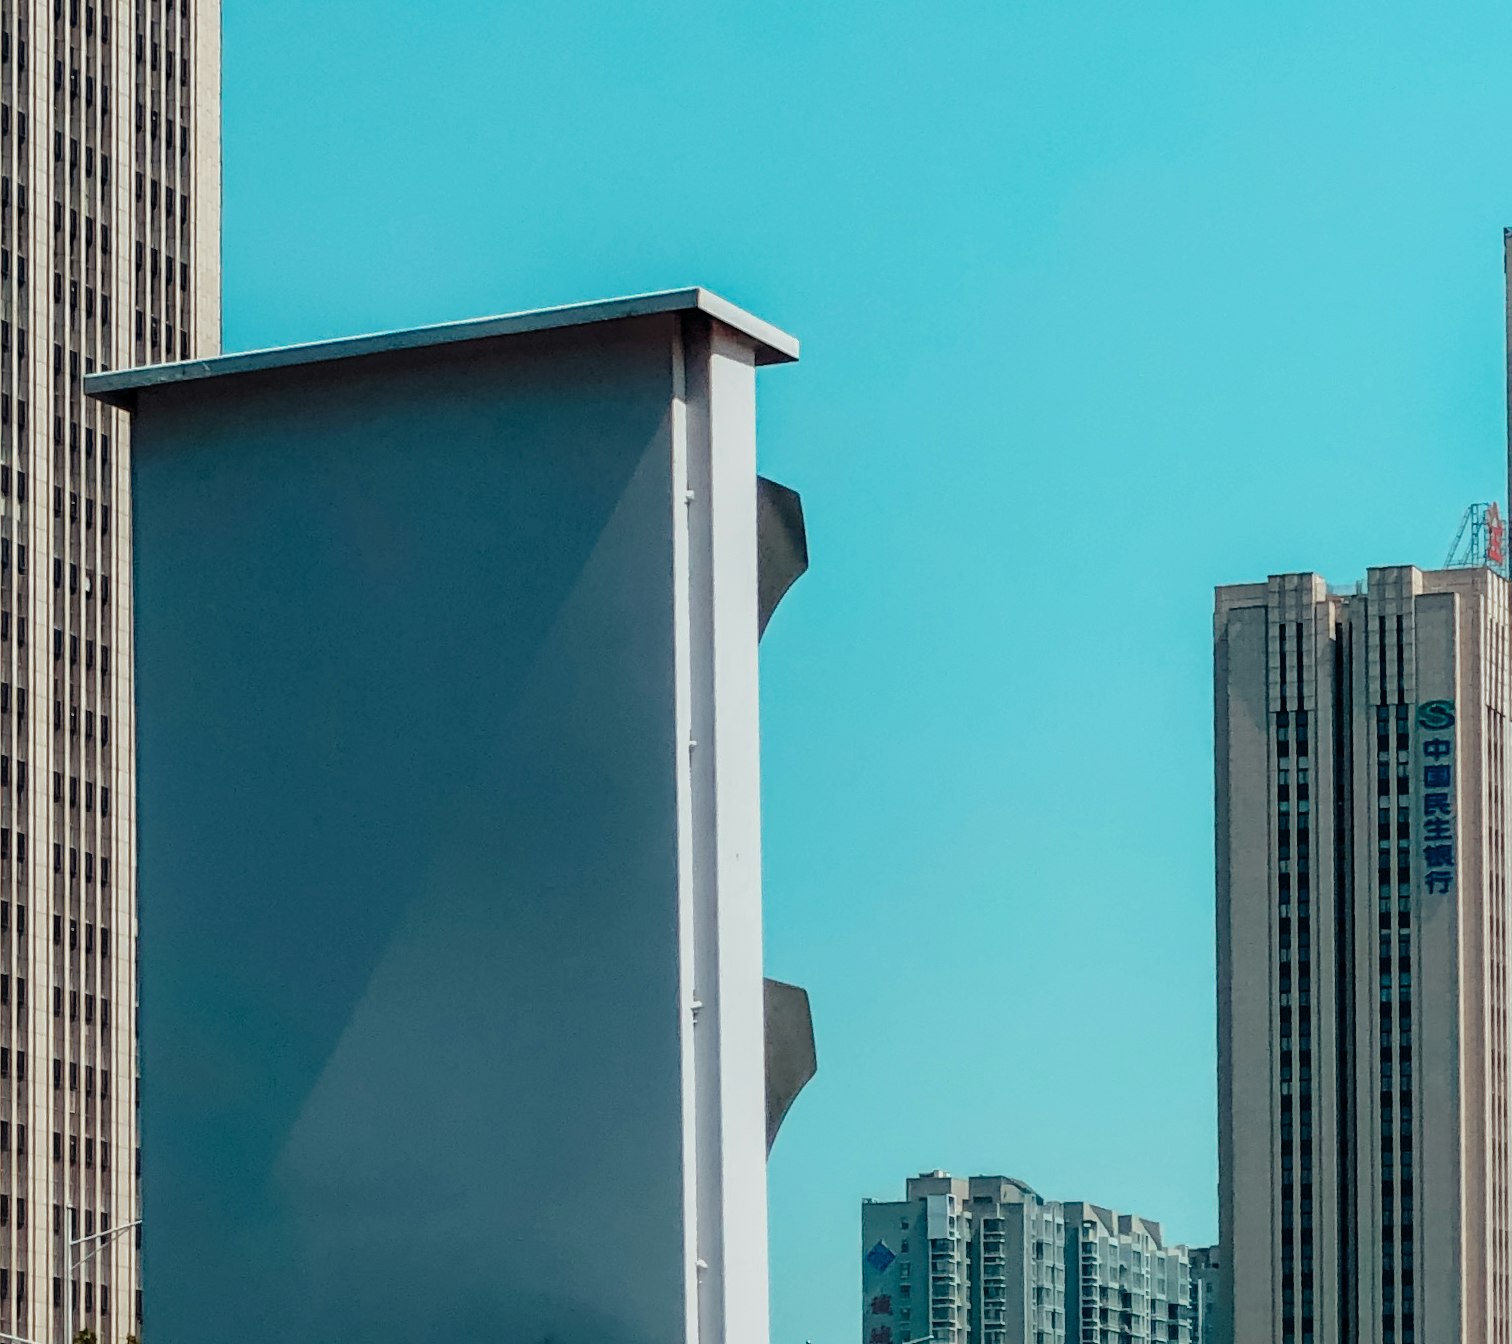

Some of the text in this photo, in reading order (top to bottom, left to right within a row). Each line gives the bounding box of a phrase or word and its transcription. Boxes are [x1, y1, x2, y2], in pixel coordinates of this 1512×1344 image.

[1423, 738, 1454, 895] 中国民生银行
